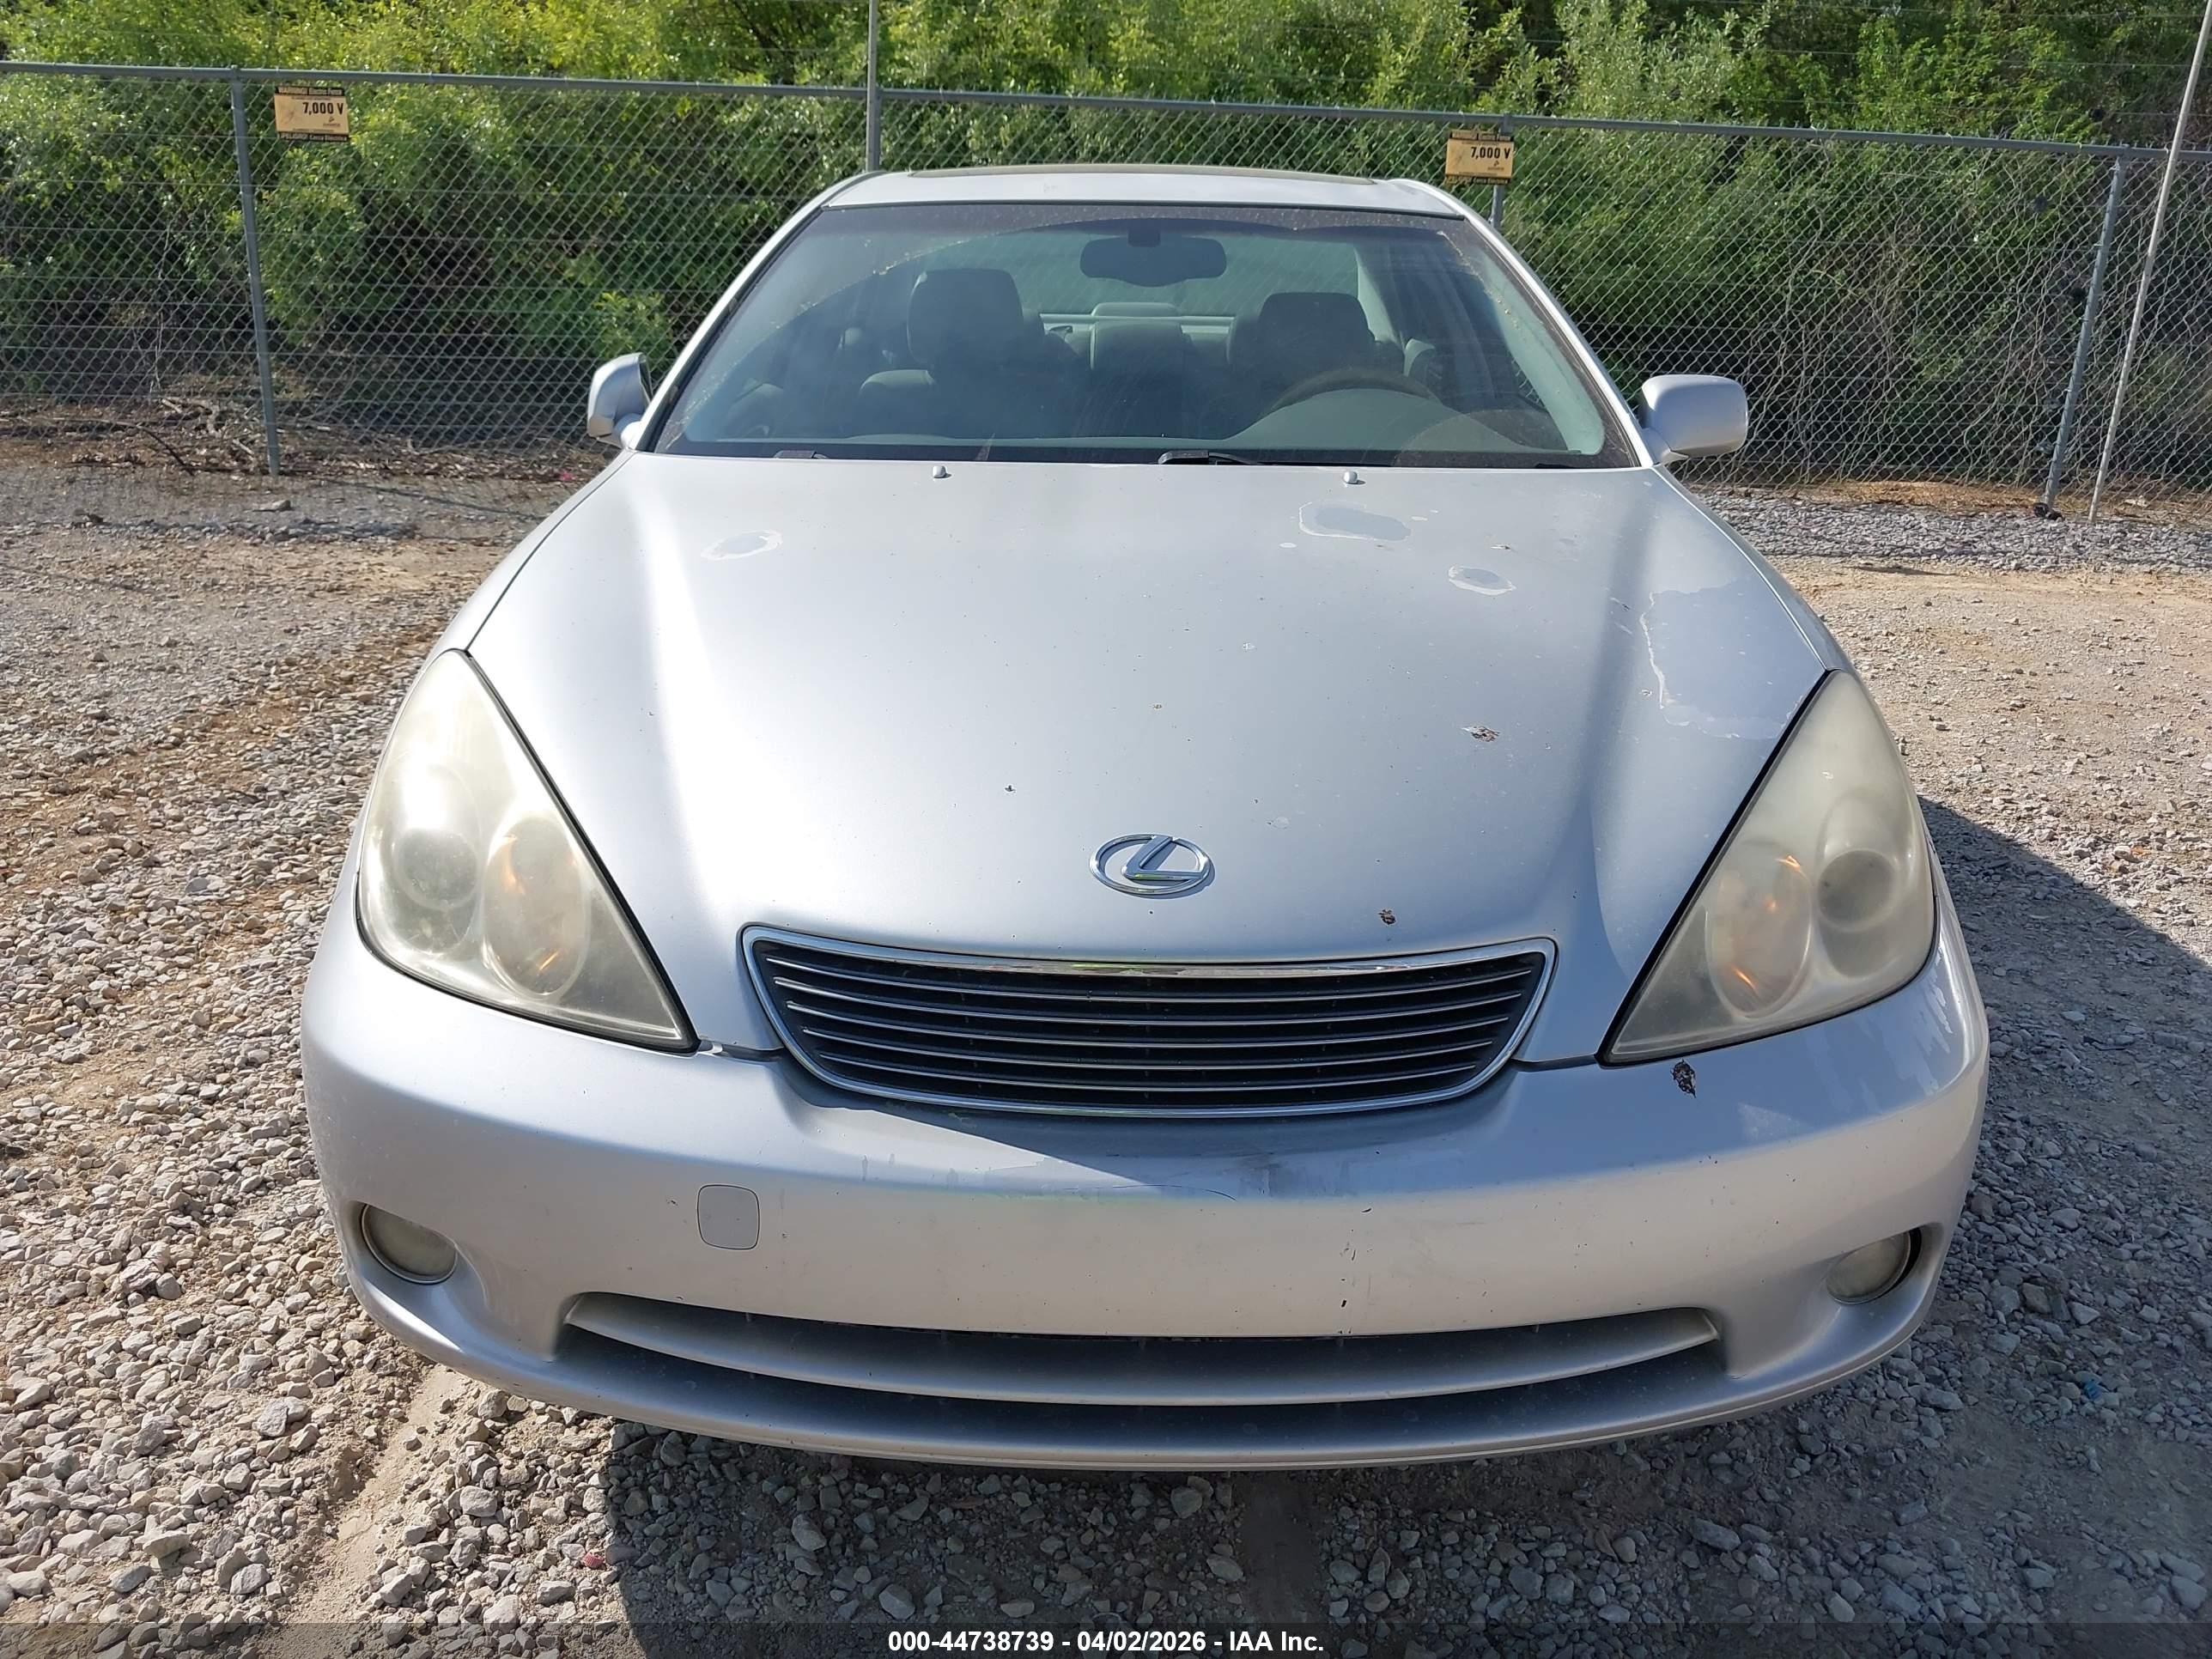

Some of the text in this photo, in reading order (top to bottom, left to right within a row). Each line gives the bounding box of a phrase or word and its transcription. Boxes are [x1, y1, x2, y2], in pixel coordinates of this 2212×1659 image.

[302, 102, 344, 116] 7,000 V
[1470, 146, 1511, 161] 7,000 V
